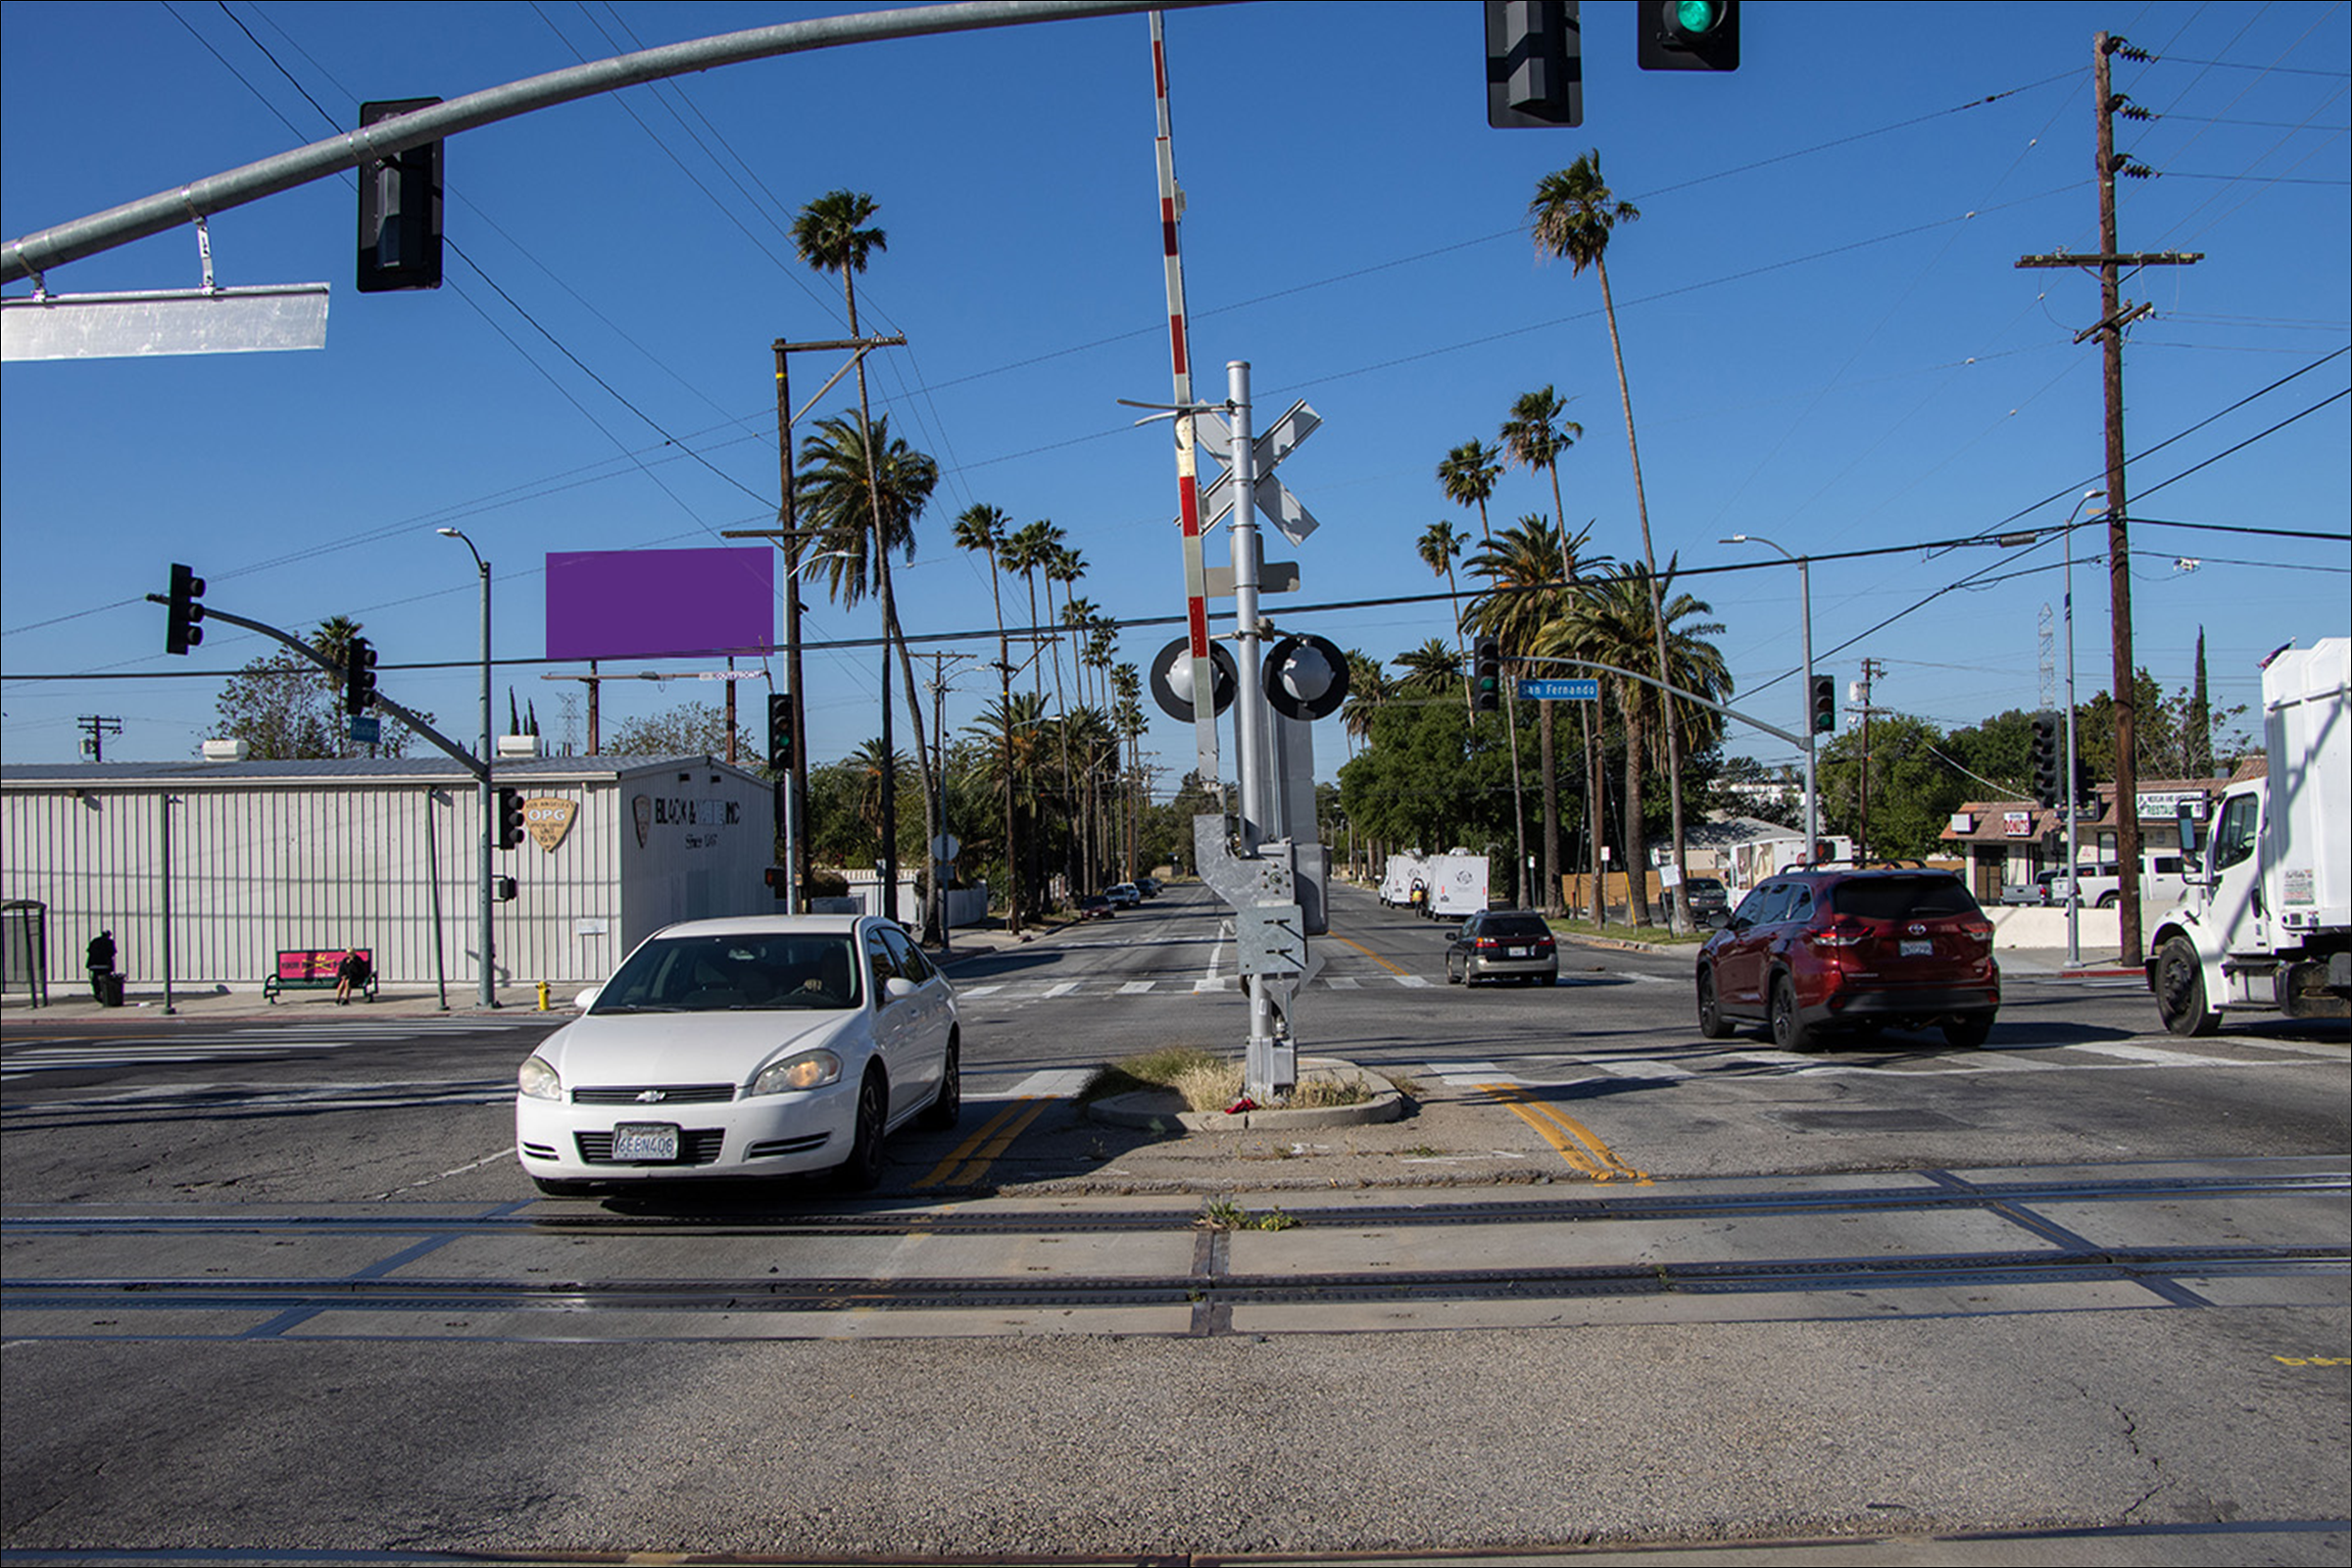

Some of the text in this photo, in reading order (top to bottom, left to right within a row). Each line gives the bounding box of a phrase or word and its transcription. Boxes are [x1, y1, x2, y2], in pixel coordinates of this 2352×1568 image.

[1522, 684, 1595, 695] San Fernando
[528, 808, 565, 821] OPG
[2004, 819, 2029, 833] DONUTS
